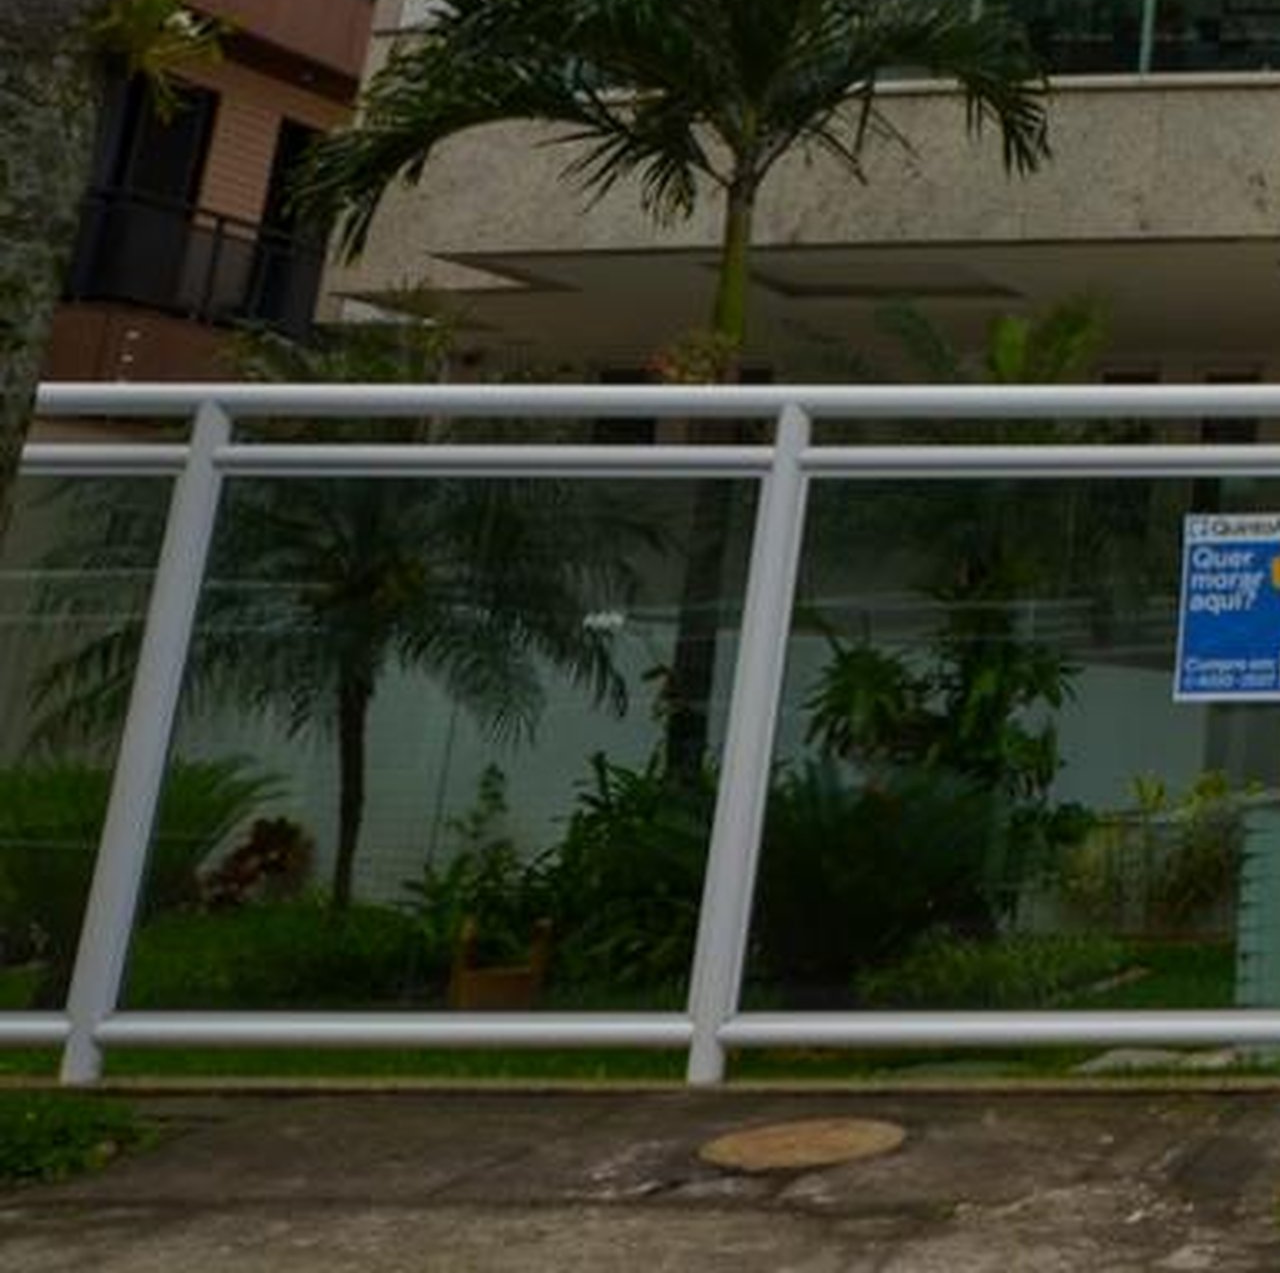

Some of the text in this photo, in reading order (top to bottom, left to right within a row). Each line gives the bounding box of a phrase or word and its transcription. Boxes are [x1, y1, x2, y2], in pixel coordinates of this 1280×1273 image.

[1192, 546, 1255, 570] Quer
[1190, 571, 1265, 591] morar
[1189, 591, 1257, 616] aqui?
